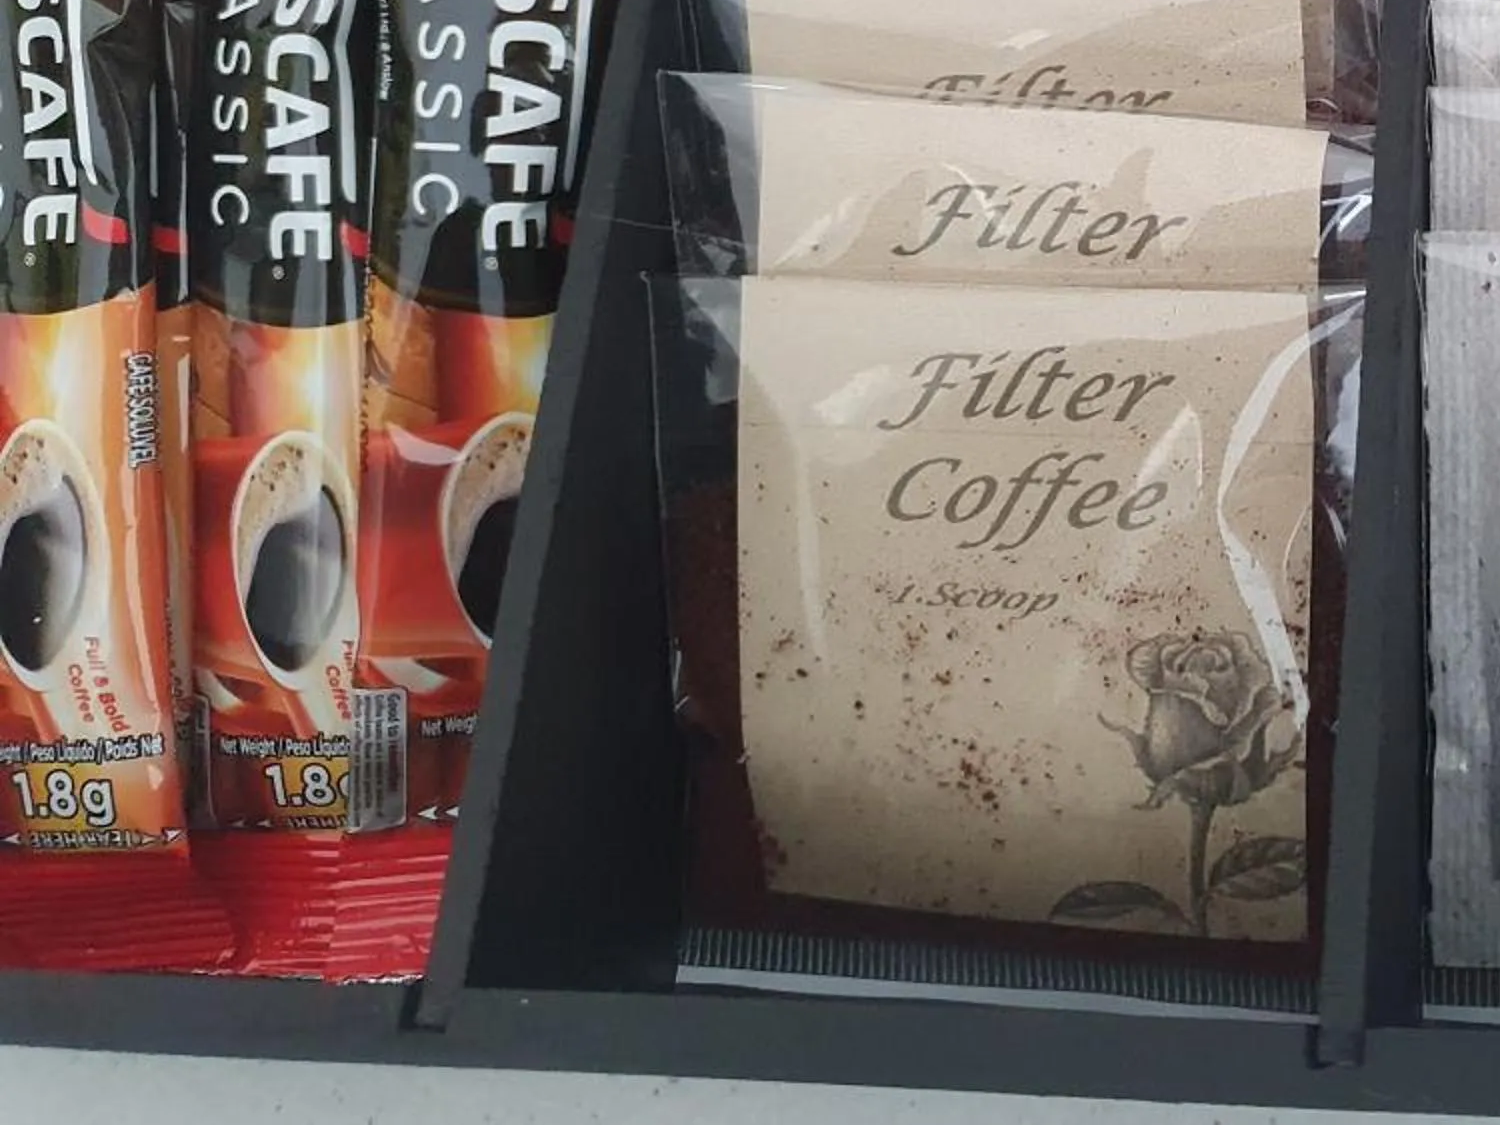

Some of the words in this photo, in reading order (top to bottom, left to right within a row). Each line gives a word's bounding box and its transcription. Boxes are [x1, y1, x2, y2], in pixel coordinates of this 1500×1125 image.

[892, 178, 1190, 262] Filter
[875, 346, 1177, 432] Filter
[884, 451, 1171, 552] Coffee
[68, 663, 96, 724] Coffee
[84, 635, 107, 671] Full
[97, 691, 131, 733] Bold
[325, 664, 352, 720] Coffee
[140, 734, 164, 756] Net
[220, 736, 239, 755] Net
[239, 736, 276, 758] Weight
[285, 738, 312, 757] Peso
[421, 721, 443, 738] Net
